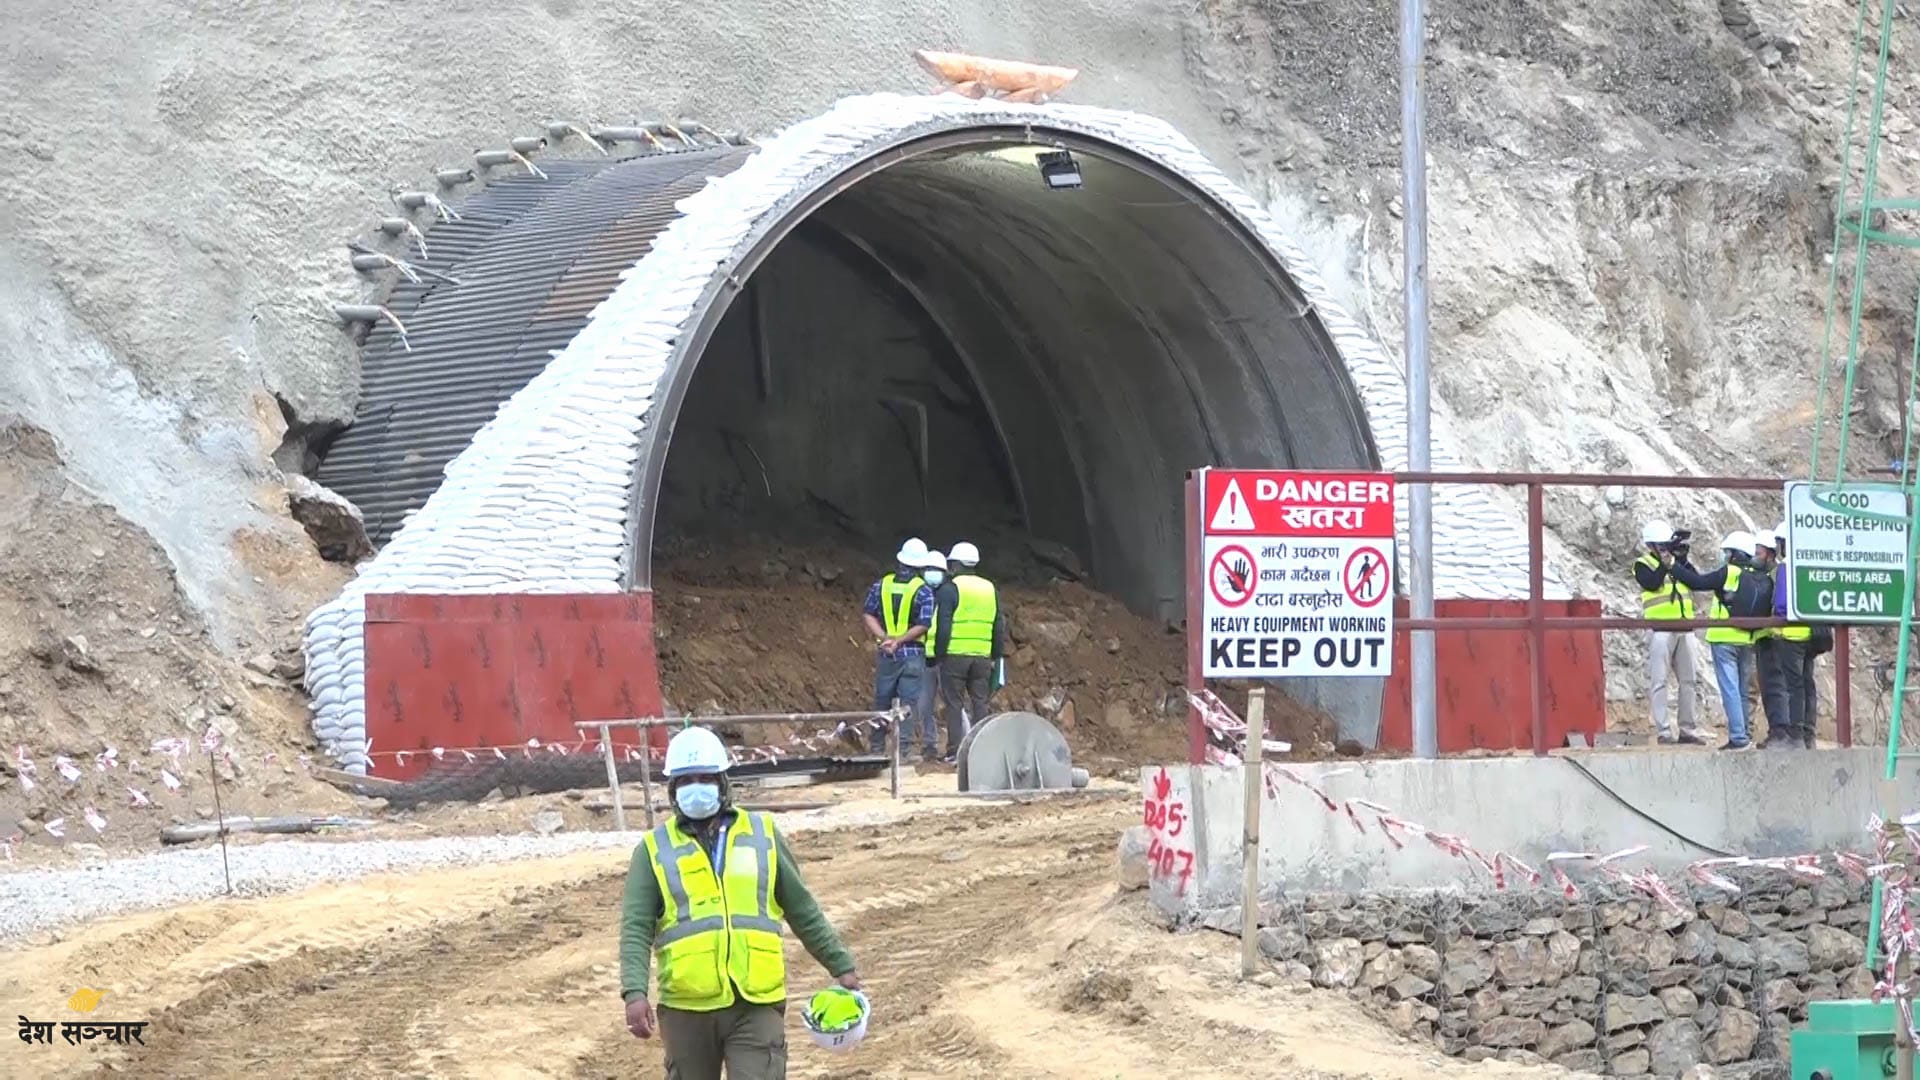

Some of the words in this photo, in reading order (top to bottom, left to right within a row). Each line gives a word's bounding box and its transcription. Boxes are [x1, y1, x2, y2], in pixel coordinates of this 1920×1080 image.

[1256, 479, 1389, 503] DANGER
[1281, 506, 1365, 529] खतरा
[1795, 513, 1904, 532] HOUSEKEEPING
[1845, 535, 1854, 546] IS
[1261, 543, 1287, 560] भारी
[1292, 546, 1340, 560] उपकरण
[1844, 551, 1904, 563] RESPONSIBILITY
[1260, 569, 1286, 581] काम
[1808, 570, 1836, 582] KEEP
[1838, 572, 1862, 583] THIS
[1864, 573, 1892, 584] AREA
[1255, 593, 1284, 606] टाढा
[1288, 588, 1343, 611] बस्नुहोस
[1818, 589, 1883, 613] CLEAN
[1211, 617, 1250, 633] HEAVY
[1254, 617, 1323, 633] EQUIPMENT
[1329, 618, 1386, 632] WORKING
[1210, 637, 1301, 668] KEEP
[1313, 637, 1385, 668] OUT
[1147, 839, 1193, 897] 407
